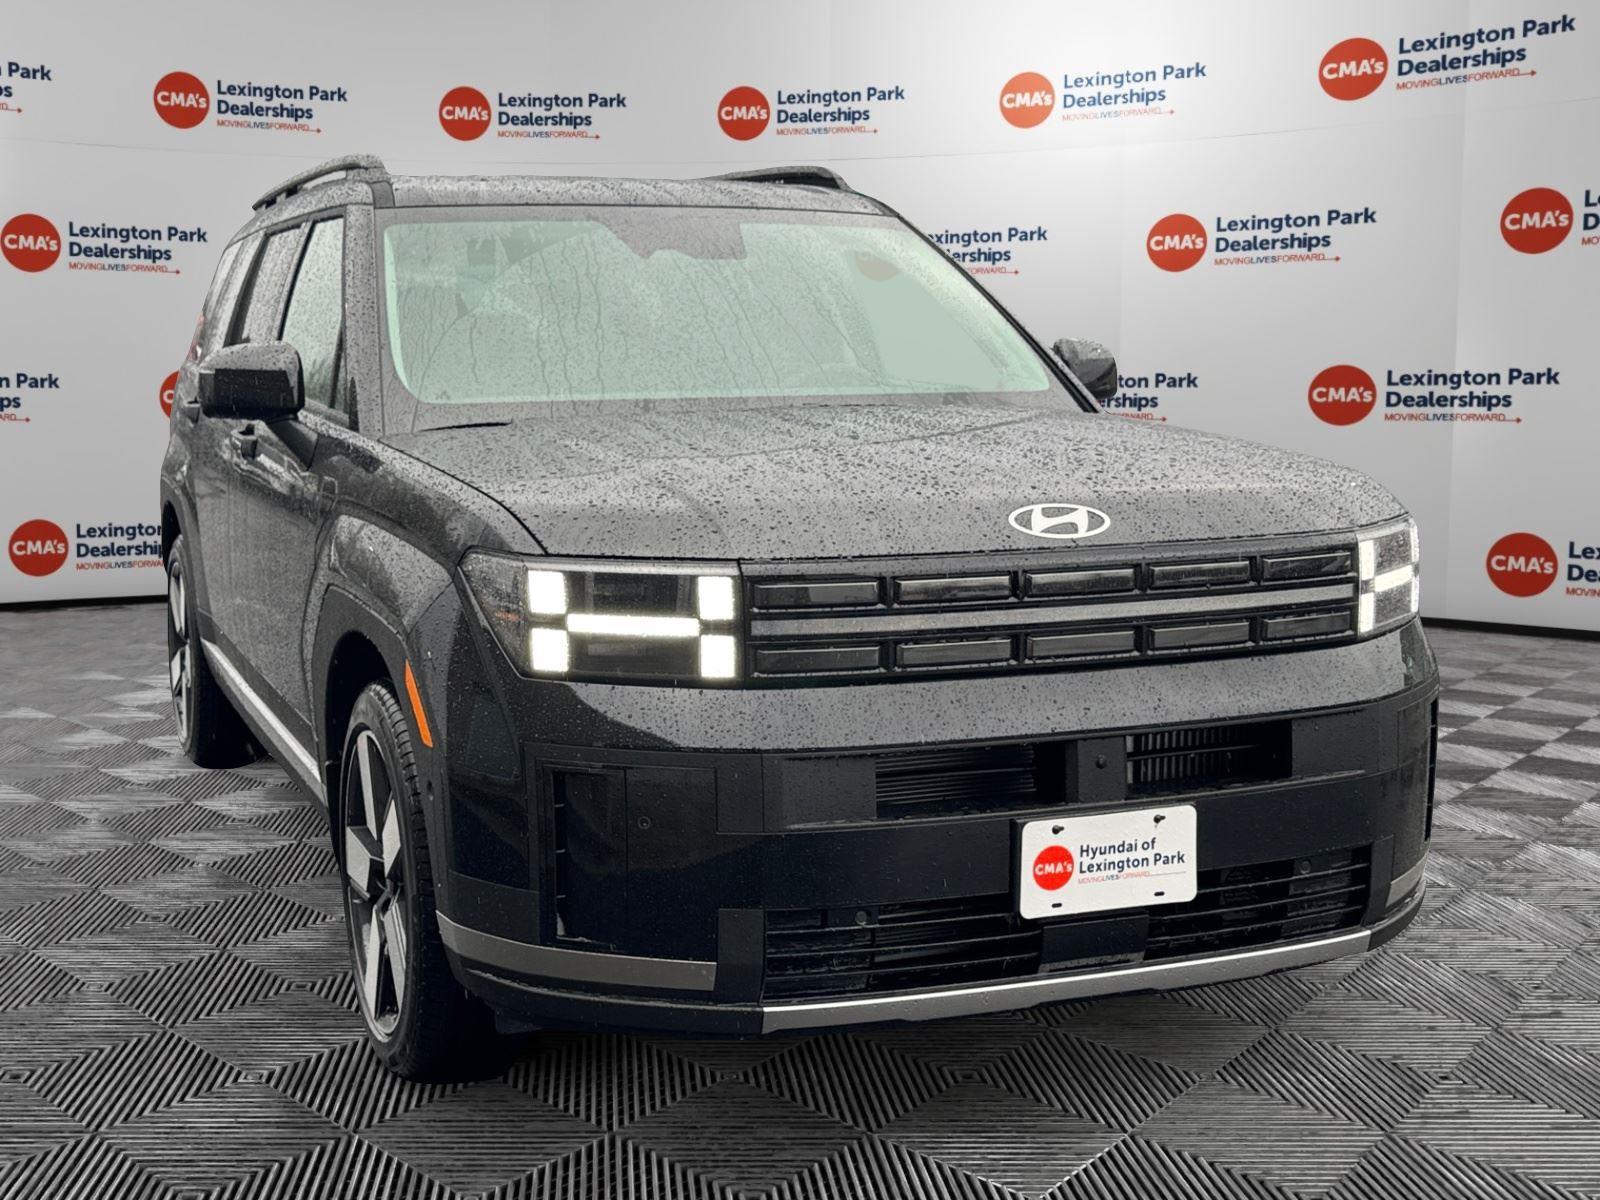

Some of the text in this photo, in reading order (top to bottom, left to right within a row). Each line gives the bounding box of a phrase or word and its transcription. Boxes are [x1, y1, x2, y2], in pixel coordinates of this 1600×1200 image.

[1399, 14, 1576, 54] Lexington Park
[8, 61, 52, 81] Park
[1322, 58, 1384, 80] CMA's
[1398, 47, 1527, 77] Dealerships
[1064, 62, 1206, 89] Lexington Park
[157, 90, 207, 109] CMA's
[217, 80, 348, 102] Lexington Park
[777, 86, 905, 107] Lexington Park
[1002, 91, 1053, 109] CMA's
[1063, 88, 1166, 109] Dealerships
[217, 100, 313, 122] Dealerships
[498, 93, 627, 111] Lexington Park
[442, 106, 489, 121] CMA's
[498, 112, 592, 129] Dealerships
[721, 105, 768, 120] CMA's
[777, 107, 870, 124] Dealerships
[1216, 207, 1376, 233] Lexington Park
[1504, 209, 1569, 230] CMA's
[69, 221, 207, 243] Lexington Park
[928, 226, 1048, 247] xington Park
[4, 234, 58, 251] CMA's
[69, 242, 172, 263] Dealerships
[1150, 234, 1204, 251] CMA's
[1215, 233, 1330, 253] Dealerships
[16, 373, 60, 389] Park
[1155, 373, 1198, 388] Park
[1387, 367, 1560, 390] Lexington Park
[1312, 386, 1373, 403] CMA's
[1386, 391, 1512, 411] Dealerships
[12, 539, 66, 556] CMA's
[1491, 554, 1554, 574] CMA's
[1080, 837, 1157, 860] Hyundai of
[1034, 861, 1072, 876] CMA's
[1079, 851, 1185, 874] Lexington Park
